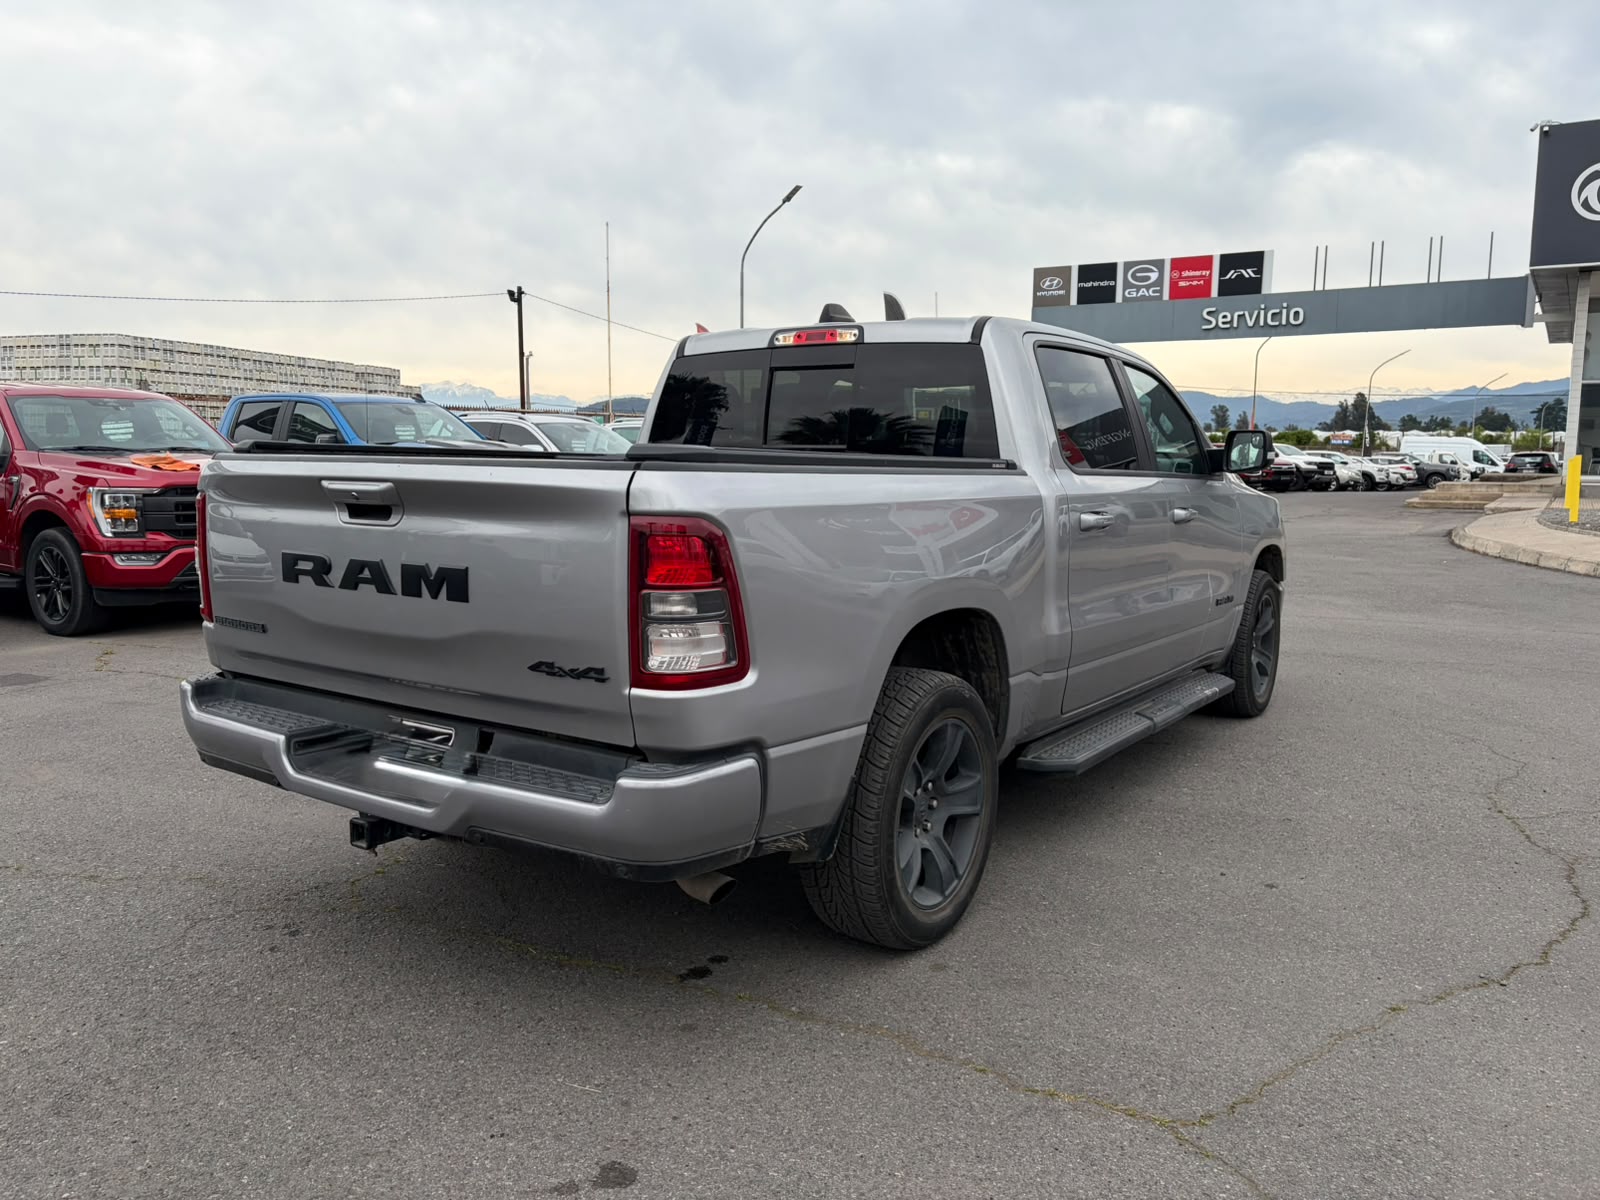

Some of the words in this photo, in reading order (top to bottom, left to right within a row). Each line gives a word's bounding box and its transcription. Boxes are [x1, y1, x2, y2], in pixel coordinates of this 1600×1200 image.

[1078, 279, 1116, 288] mahindra
[1124, 286, 1161, 298] GAC
[1201, 302, 1305, 330] Servicio
[281, 550, 470, 603] RAM
